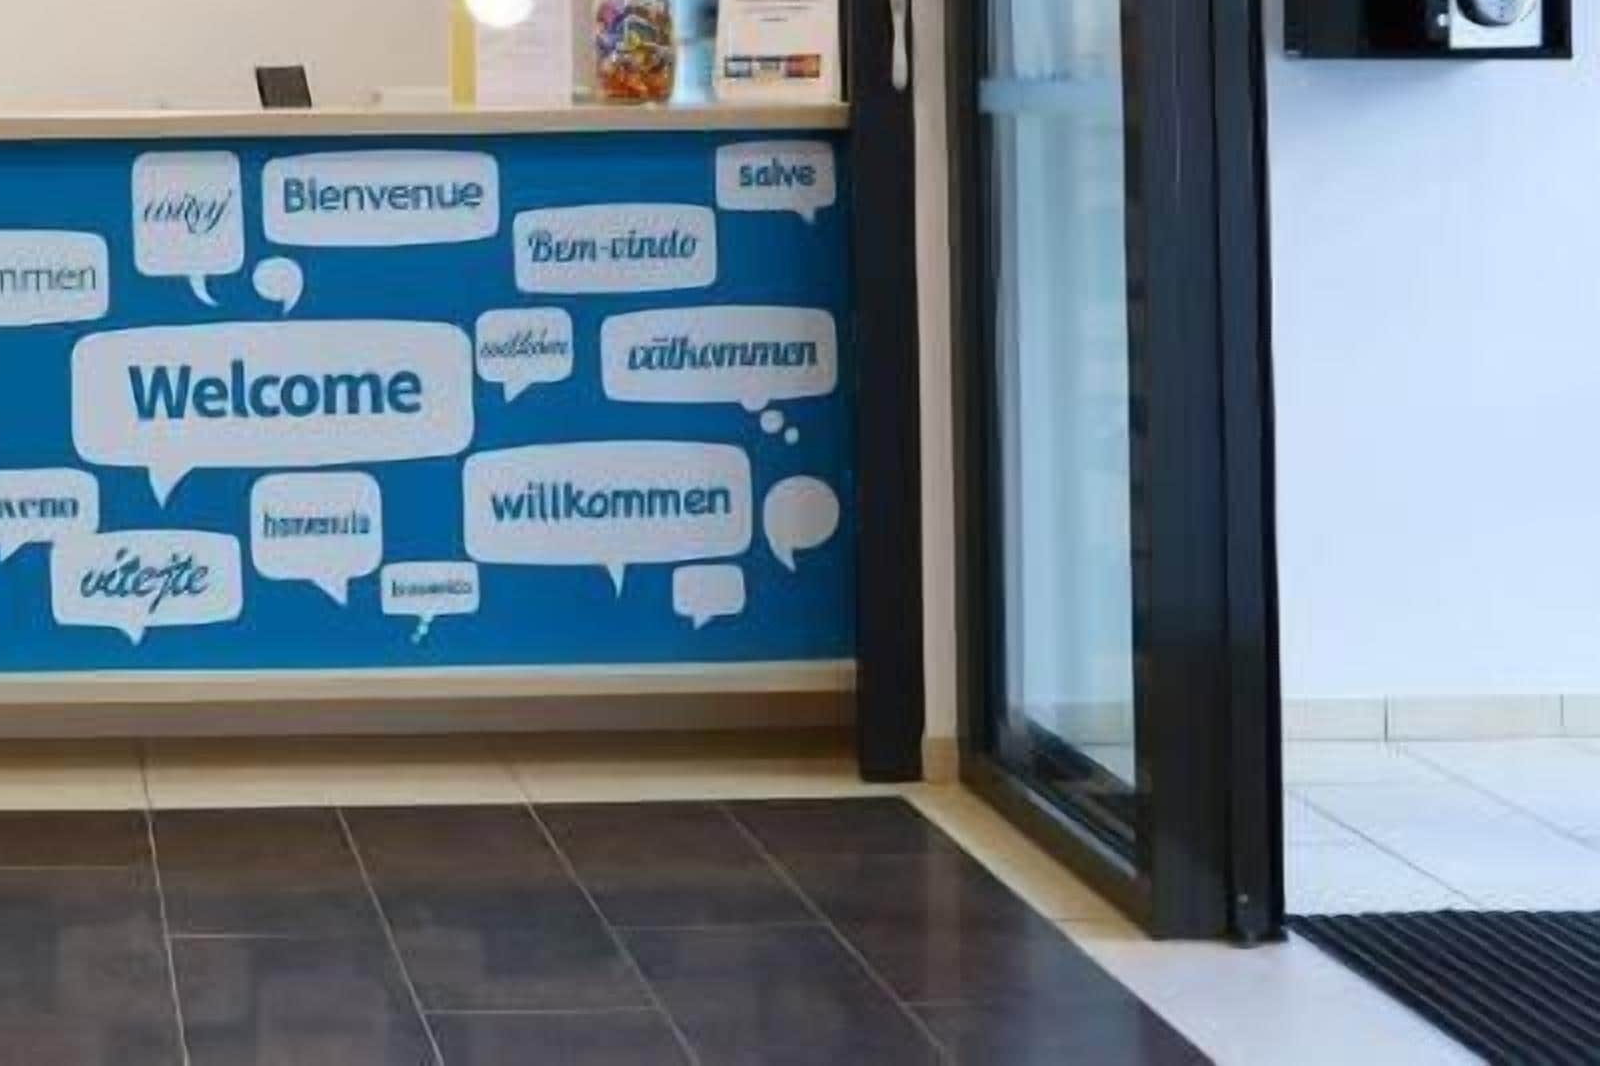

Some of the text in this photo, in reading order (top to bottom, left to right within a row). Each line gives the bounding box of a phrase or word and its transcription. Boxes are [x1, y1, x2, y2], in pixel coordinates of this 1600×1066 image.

[739, 157, 817, 188] salve
[283, 177, 483, 214] Bienvenue
[527, 228, 697, 263] Bem-vindo
[127, 359, 422, 420] Welcome
[491, 482, 732, 522] willkommen
